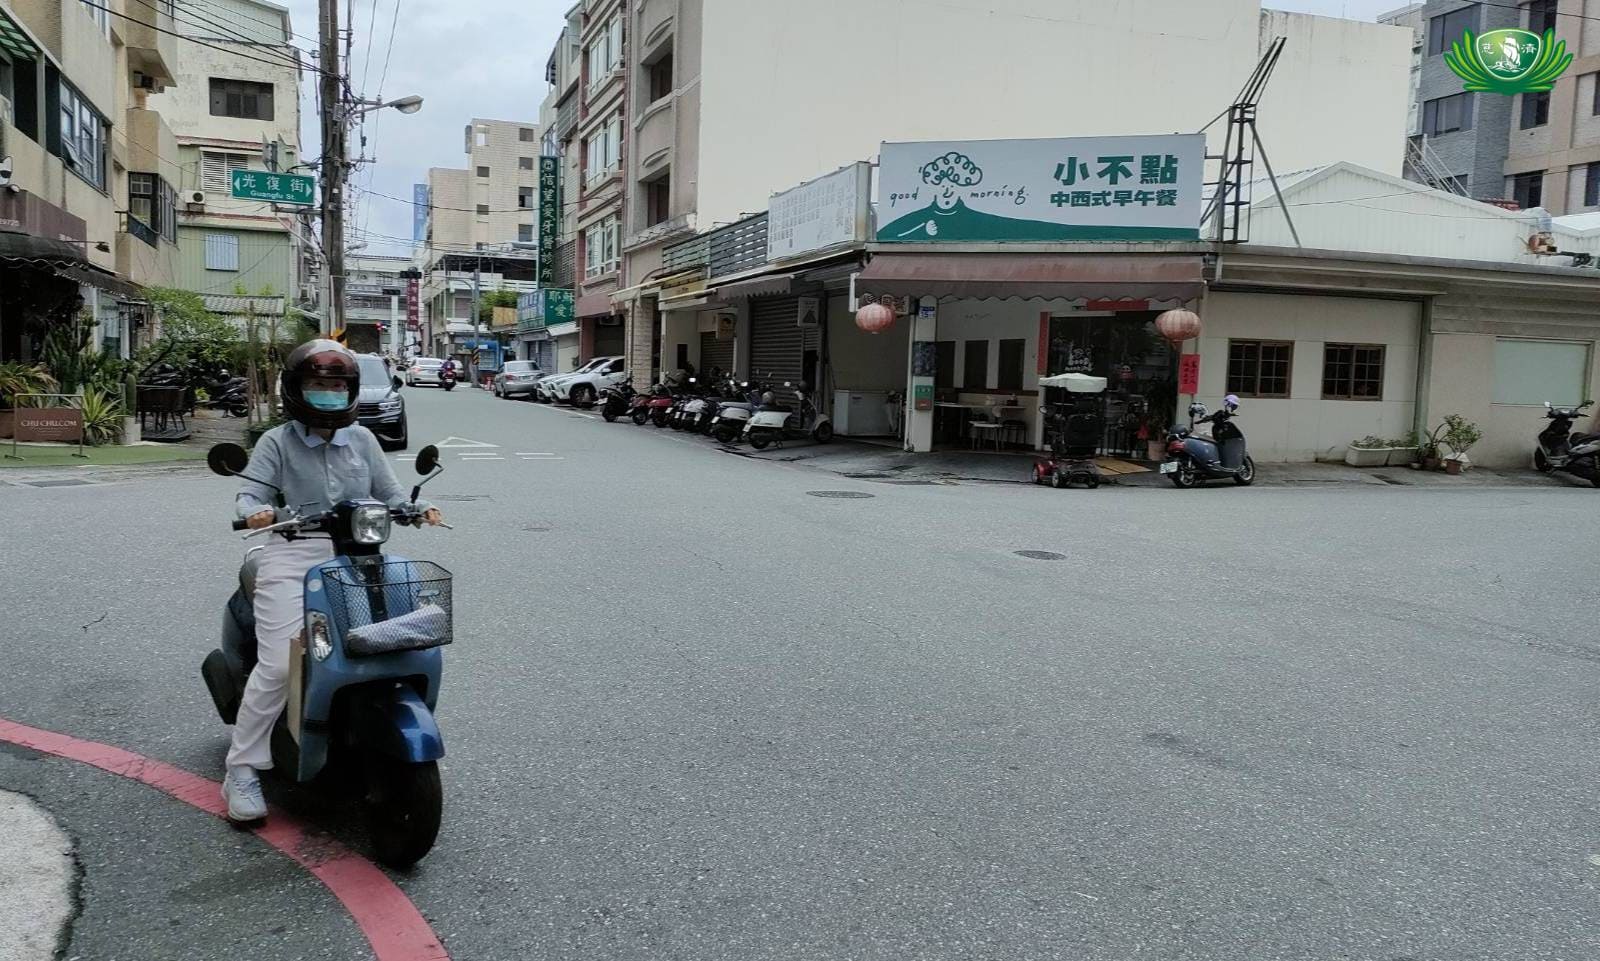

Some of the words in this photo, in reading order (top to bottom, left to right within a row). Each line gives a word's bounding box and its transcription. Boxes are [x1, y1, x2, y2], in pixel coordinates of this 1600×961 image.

[1053, 154, 1178, 186] 小不點
[242, 174, 305, 193] 光復街
[250, 190, 284, 200] Guangfu
[889, 186, 919, 207] good
[1050, 189, 1178, 207] 中西式早午餐
